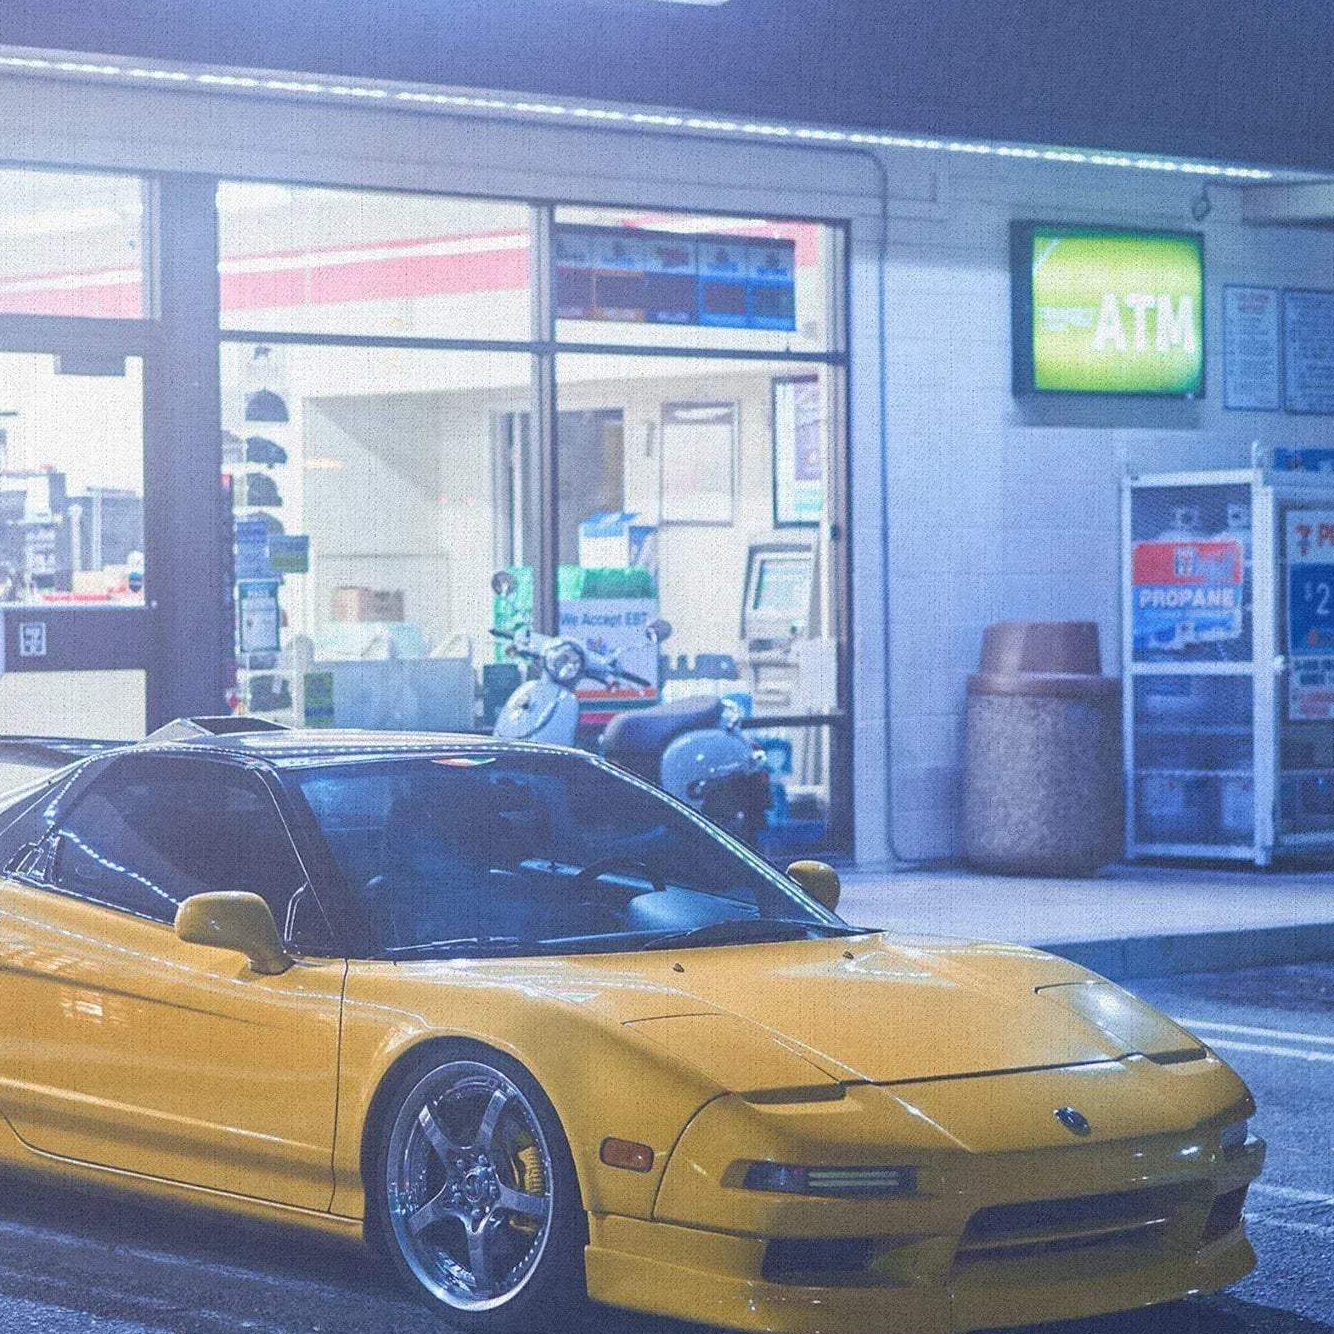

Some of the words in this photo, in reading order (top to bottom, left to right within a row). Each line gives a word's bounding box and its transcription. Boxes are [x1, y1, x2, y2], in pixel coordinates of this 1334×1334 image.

[1092, 292, 1196, 354] ATM
[1140, 587, 1234, 608] PROPANE
[582, 612, 622, 627] Accept
